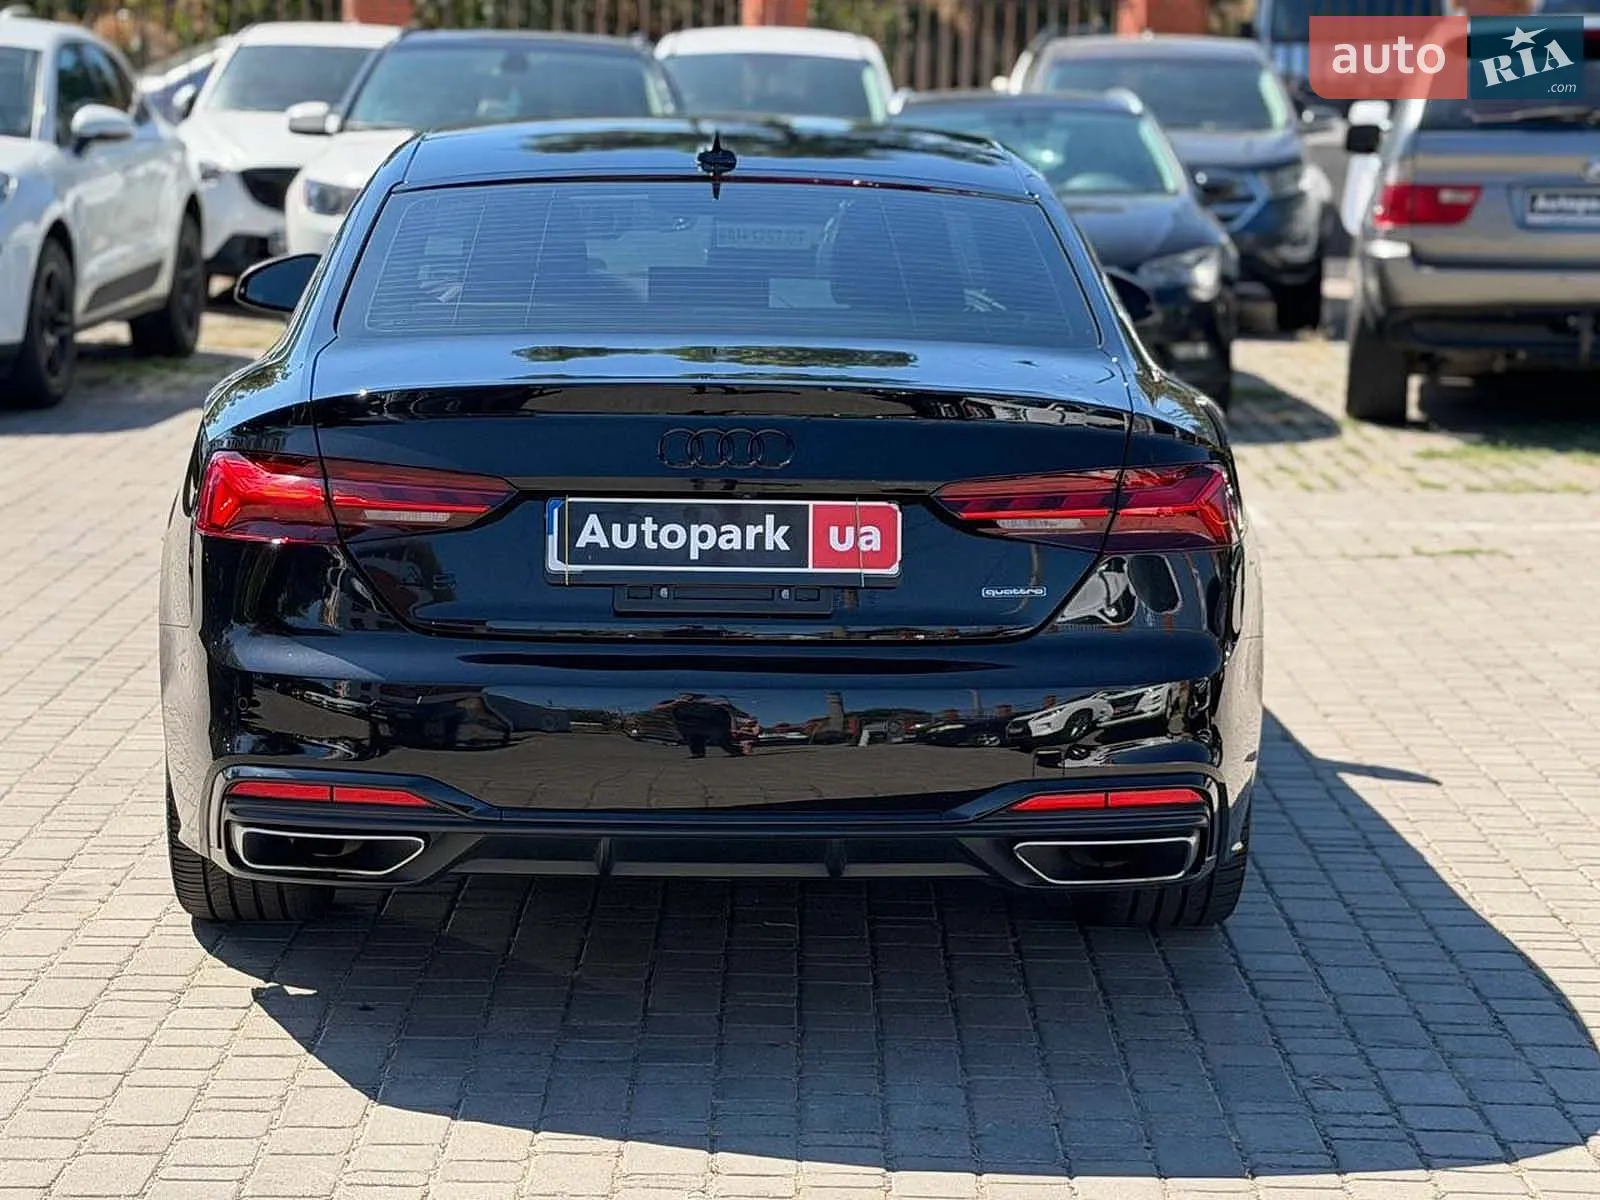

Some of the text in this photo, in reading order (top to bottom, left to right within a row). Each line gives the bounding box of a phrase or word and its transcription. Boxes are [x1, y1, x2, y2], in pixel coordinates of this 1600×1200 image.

[575, 514, 881, 560] Autopark ua
[985, 588, 1043, 597] quattro
